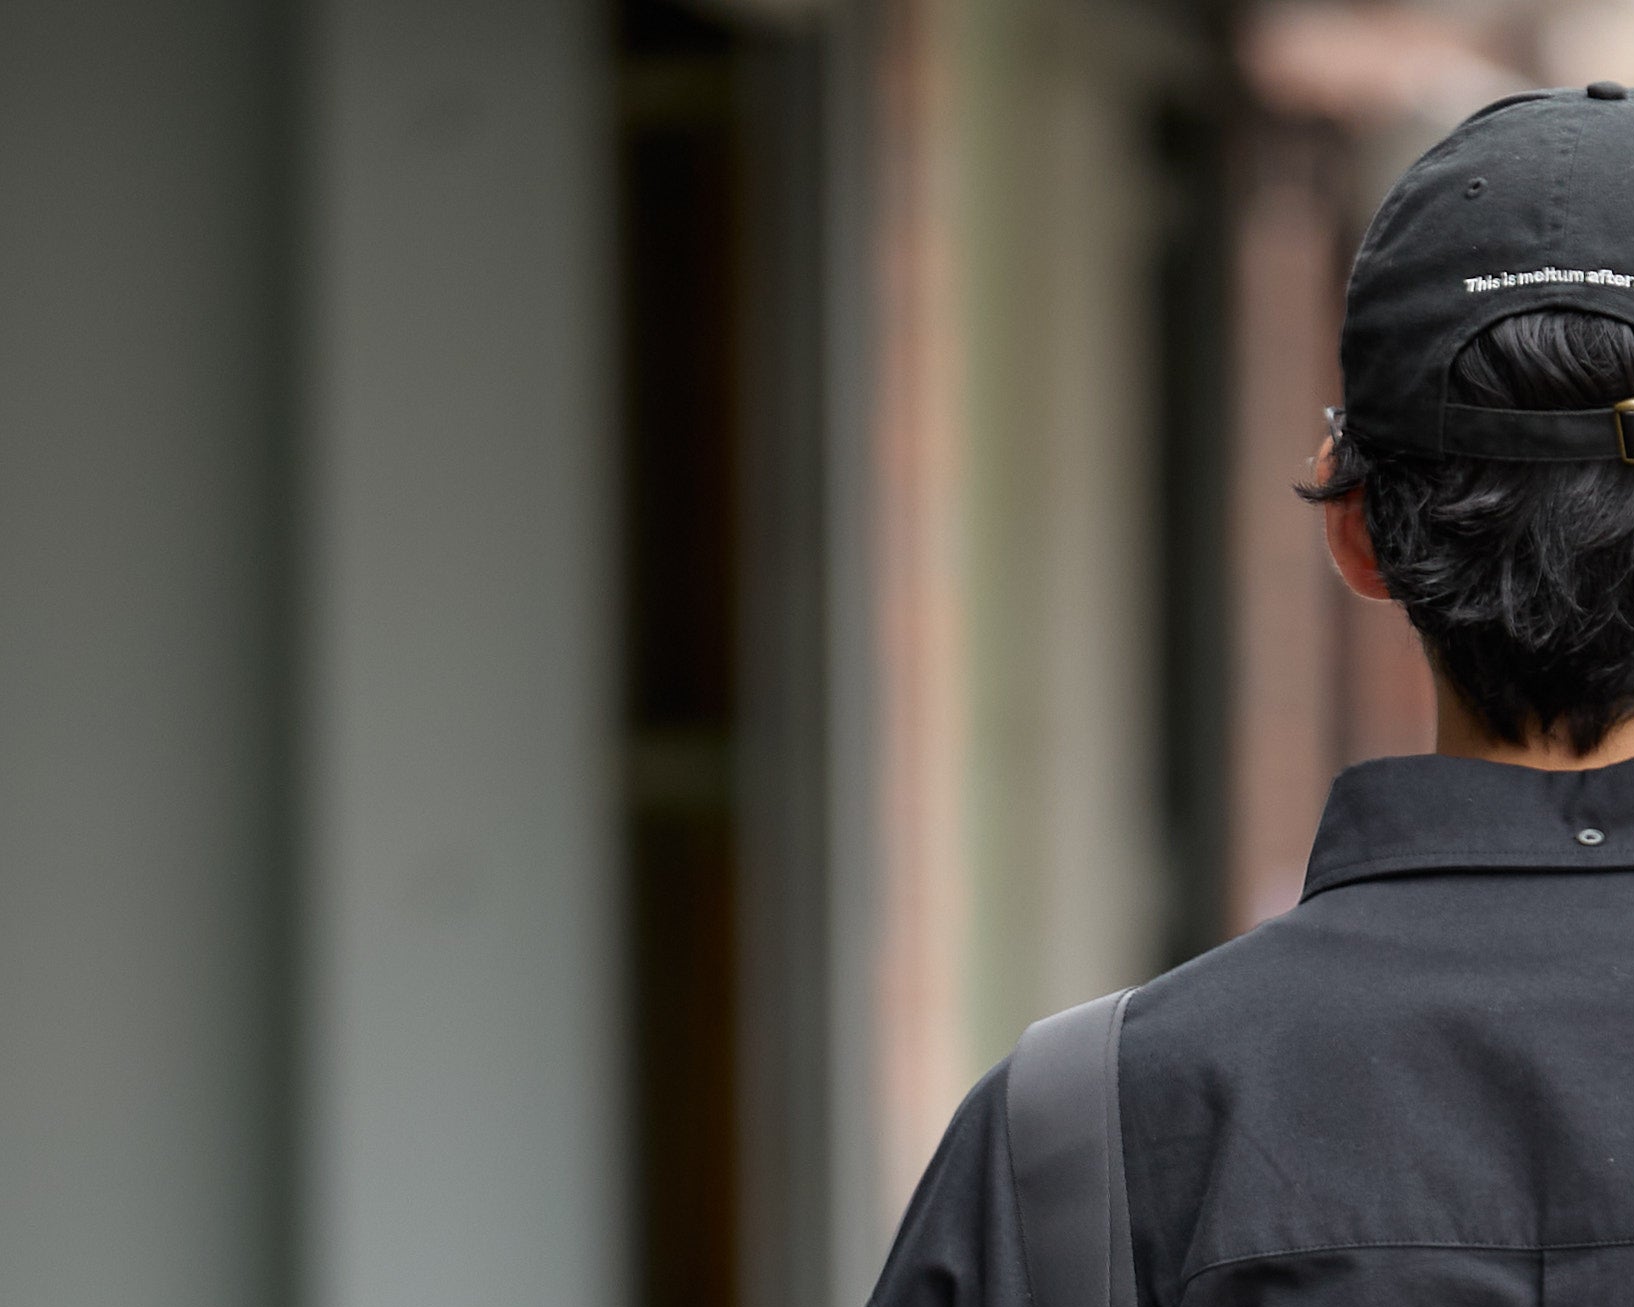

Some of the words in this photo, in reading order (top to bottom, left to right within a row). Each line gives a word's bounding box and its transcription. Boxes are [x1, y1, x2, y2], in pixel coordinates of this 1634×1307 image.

[1464, 276, 1500, 292] This
[1500, 271, 1517, 287] is
[1585, 269, 1634, 288] after
